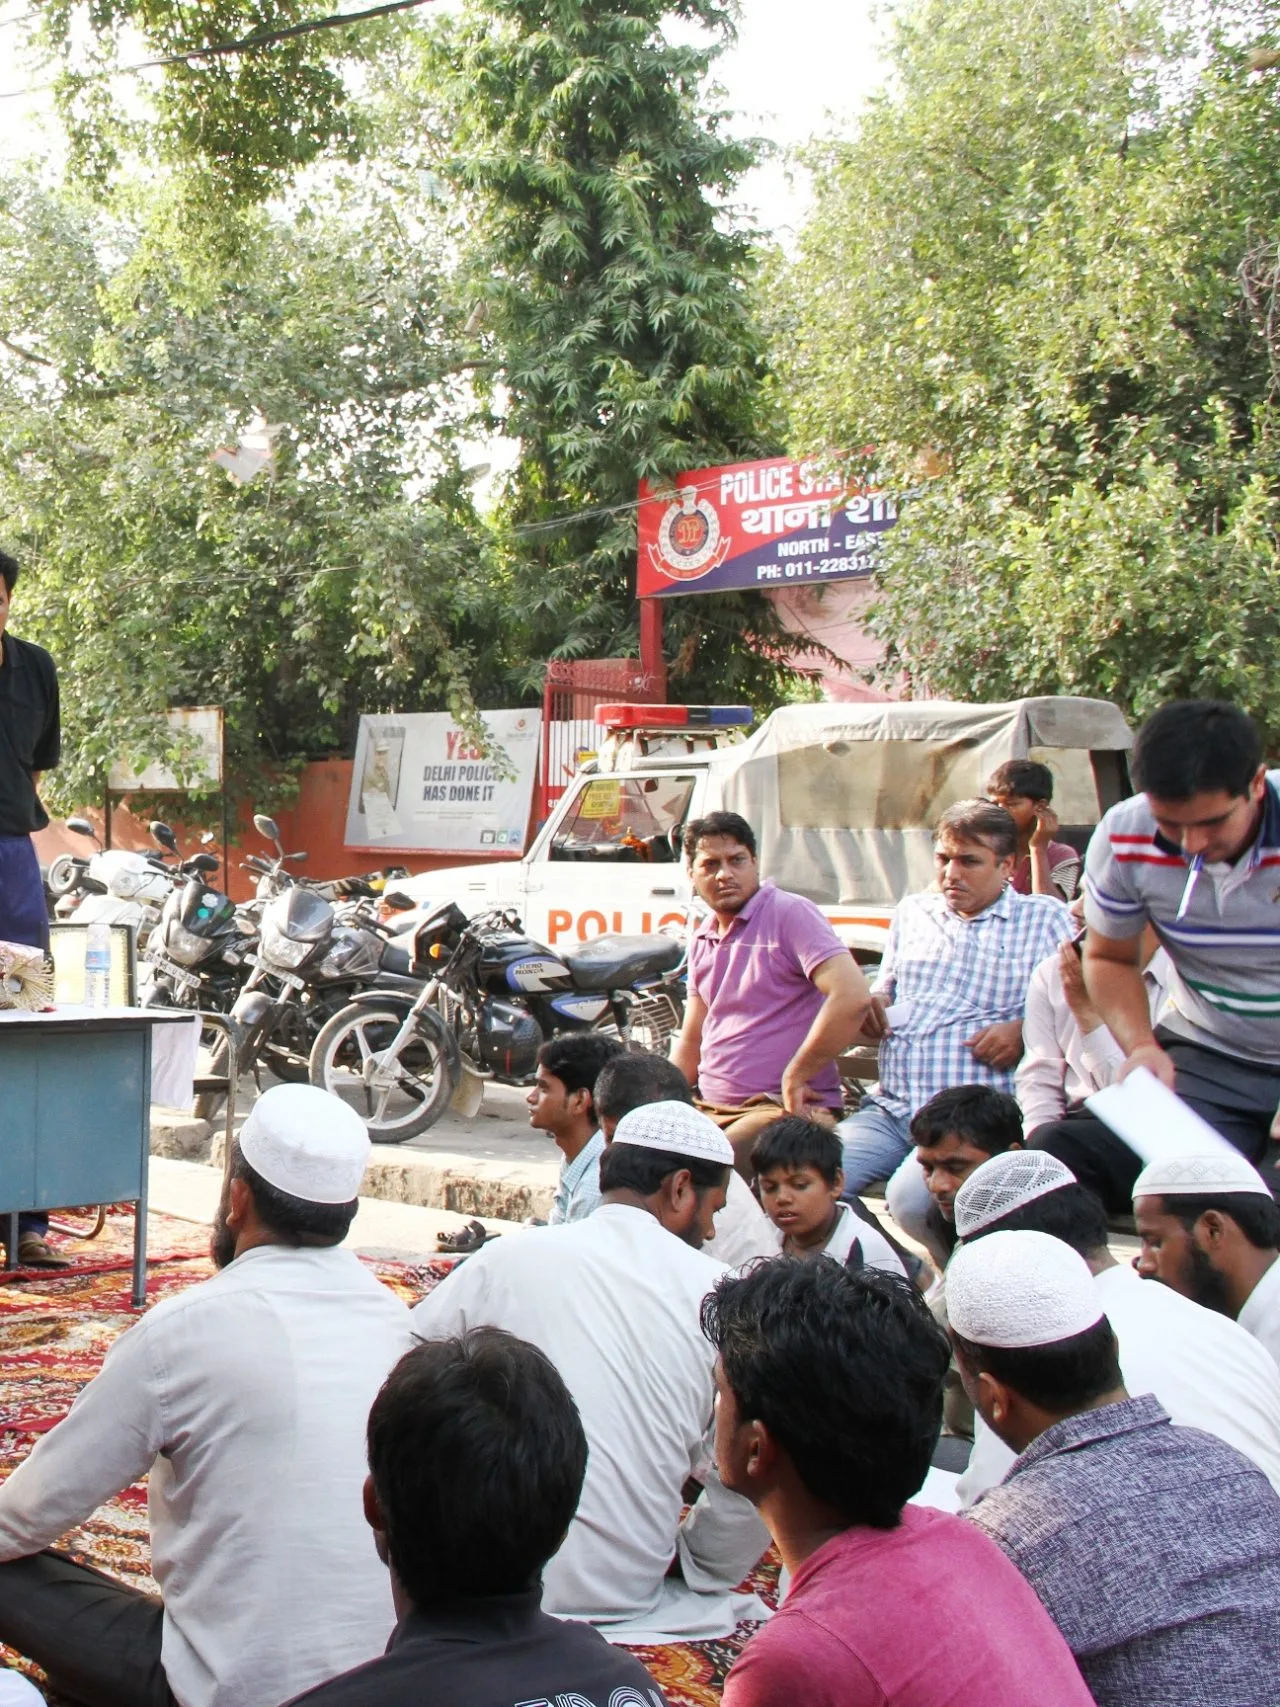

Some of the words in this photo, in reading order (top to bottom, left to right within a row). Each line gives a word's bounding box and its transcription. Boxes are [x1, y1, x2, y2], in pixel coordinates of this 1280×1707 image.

[720, 465, 793, 506] POLICE
[741, 498, 832, 535] थाना
[777, 536, 829, 558] NORTH
[757, 564, 782, 580] PH:
[423, 765, 457, 781] DELHI
[459, 765, 499, 781] POLIC
[423, 785, 447, 801] HAS
[449, 785, 480, 801] DONE
[483, 785, 495, 801] IT
[548, 909, 702, 945] POLIC
